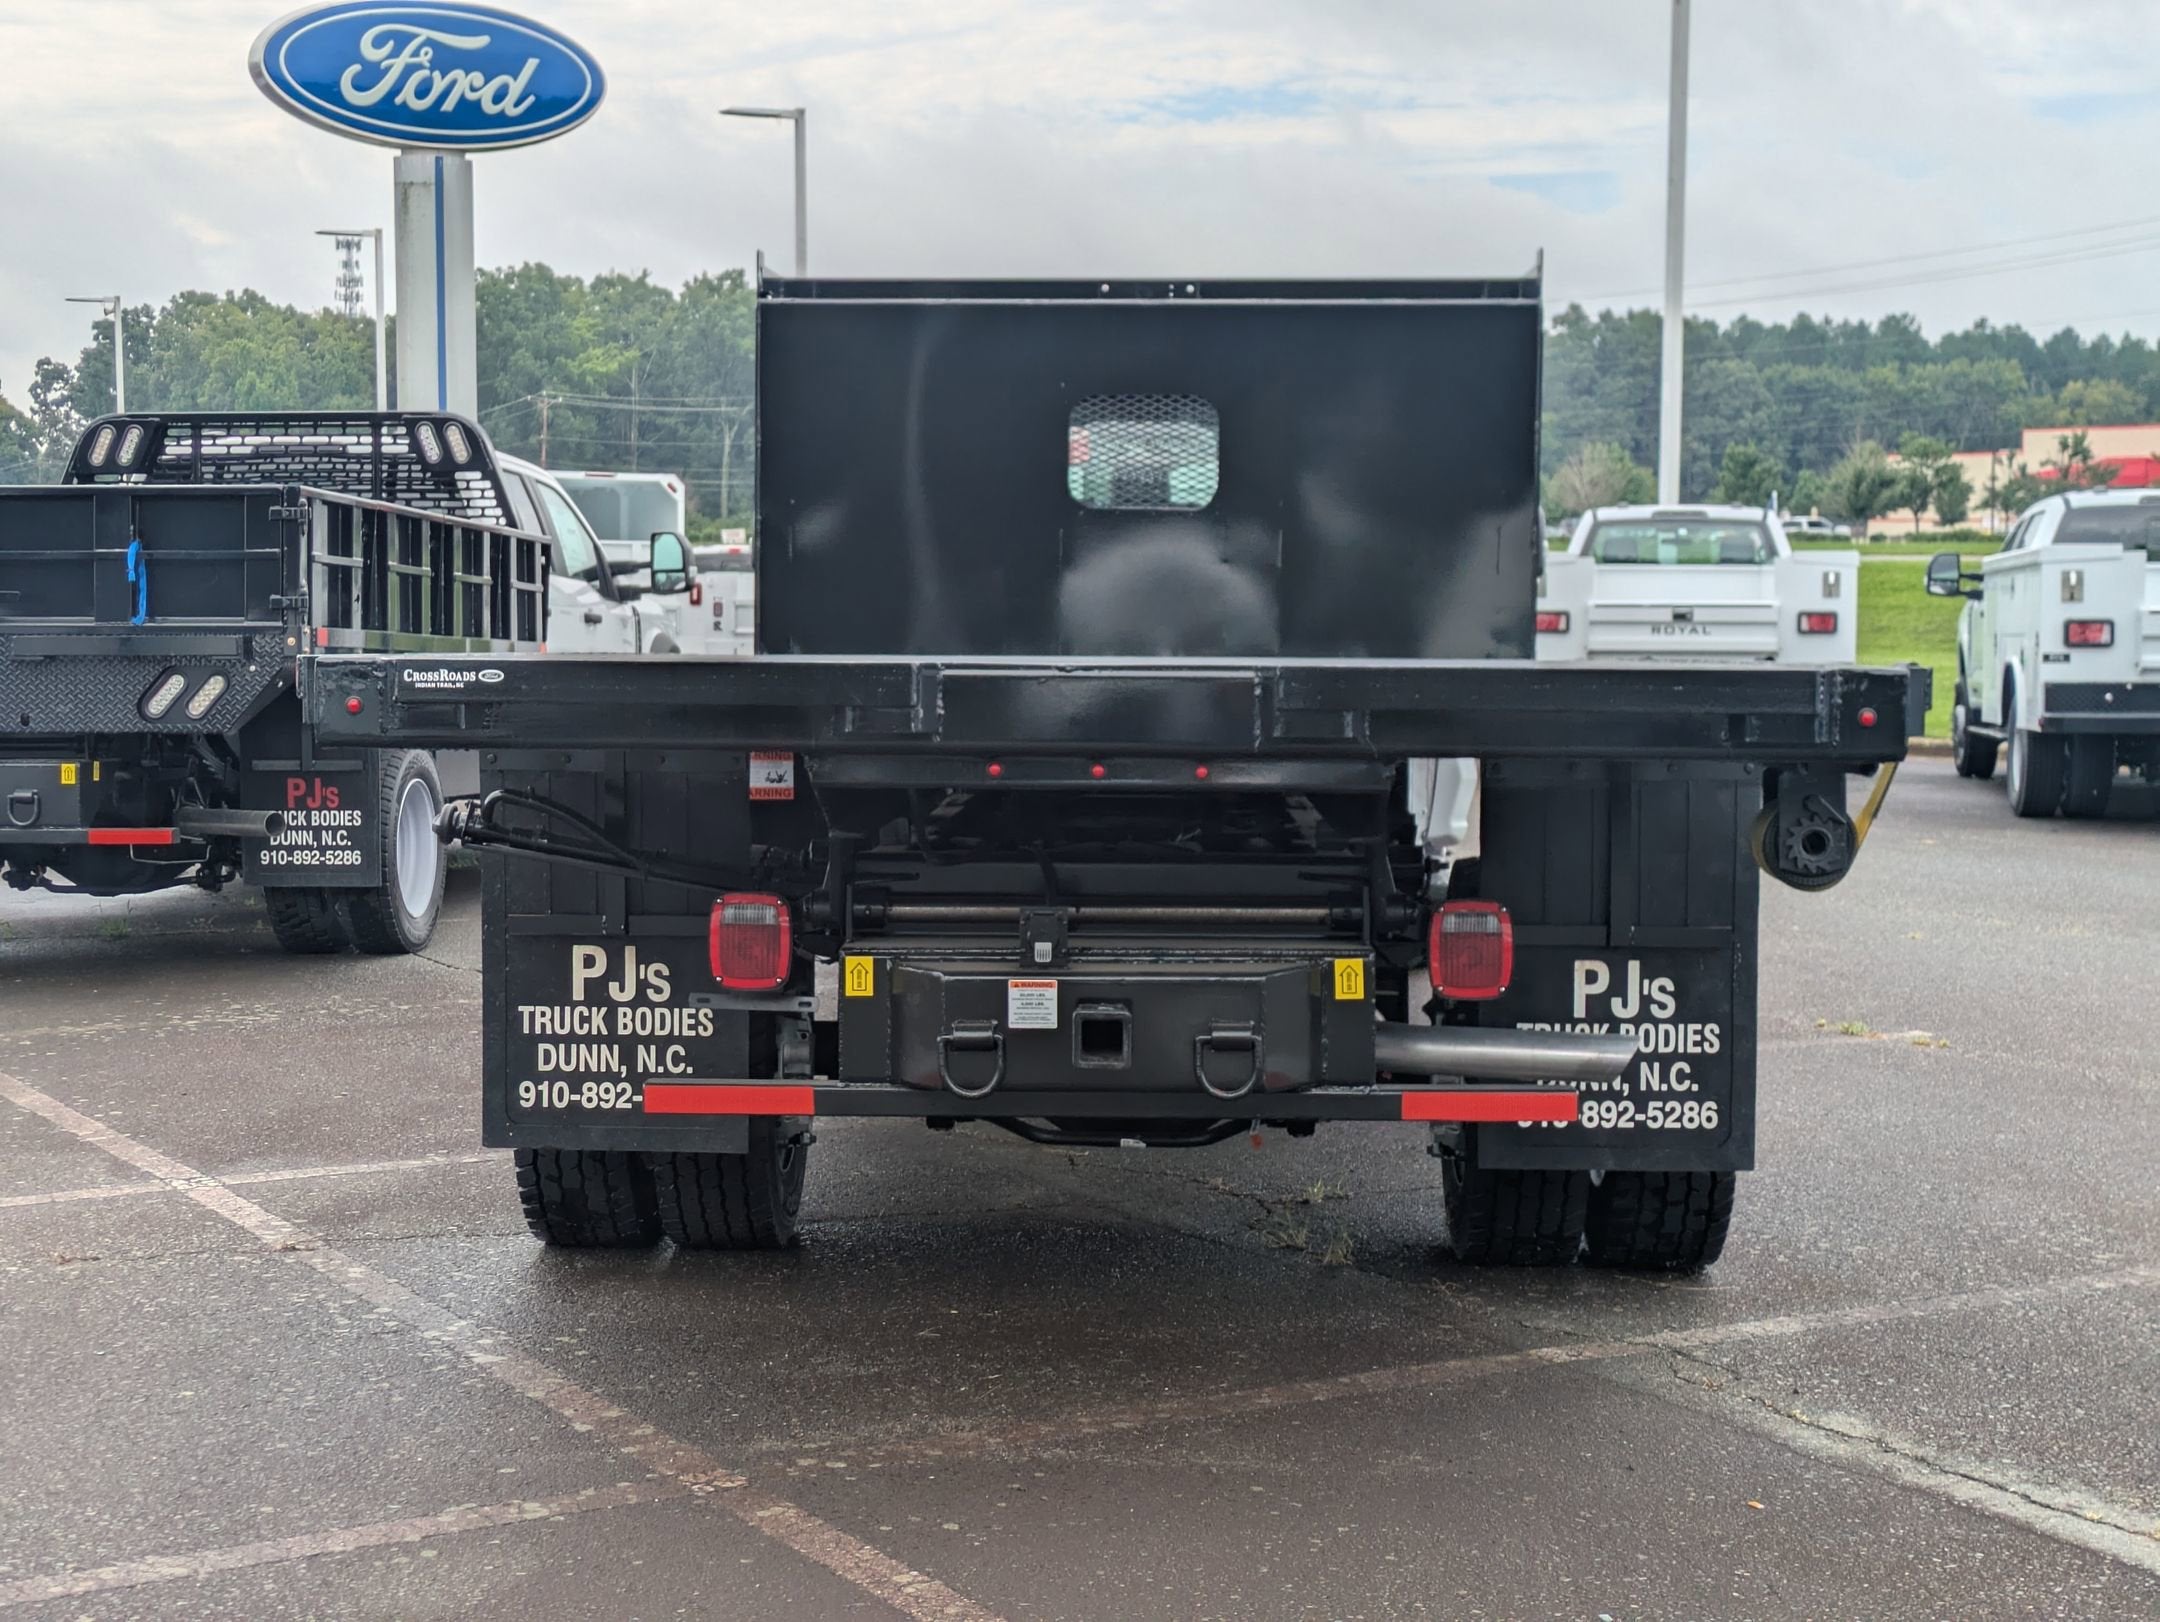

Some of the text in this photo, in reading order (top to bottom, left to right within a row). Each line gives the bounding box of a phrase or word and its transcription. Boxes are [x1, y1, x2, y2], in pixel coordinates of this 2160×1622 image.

[340, 23, 540, 117] Ford
[1651, 624, 1712, 635] ROYAL
[750, 787, 792, 798] ARNING
[310, 809, 362, 827] BODIES
[321, 829, 352, 847] N.C.
[260, 849, 362, 866] 910-892-5286
[517, 1005, 714, 1037] TRUCK BODIES
[537, 1042, 694, 1079] DUNN, N.C.
[1639, 1061, 1699, 1092] N.C.
[518, 1080, 643, 1110] 910-892-
[1516, 1099, 1719, 1130] 892-5286
